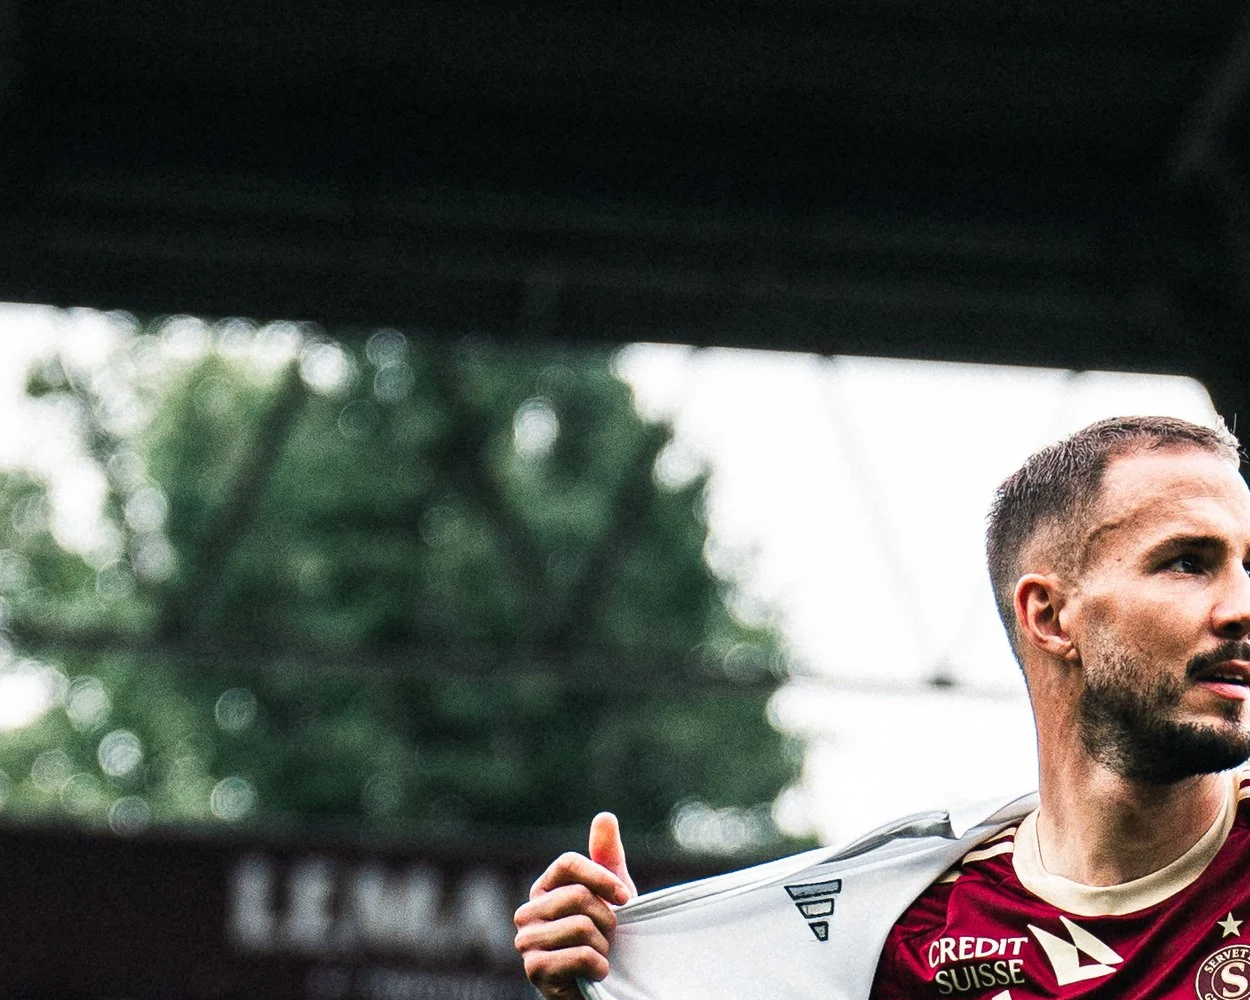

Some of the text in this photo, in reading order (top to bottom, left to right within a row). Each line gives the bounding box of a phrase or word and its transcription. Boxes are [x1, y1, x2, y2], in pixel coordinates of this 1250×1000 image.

[928, 936, 1028, 969] CREDIT
[934, 958, 1025, 994] SUISSE
[1221, 961, 1248, 998] S
